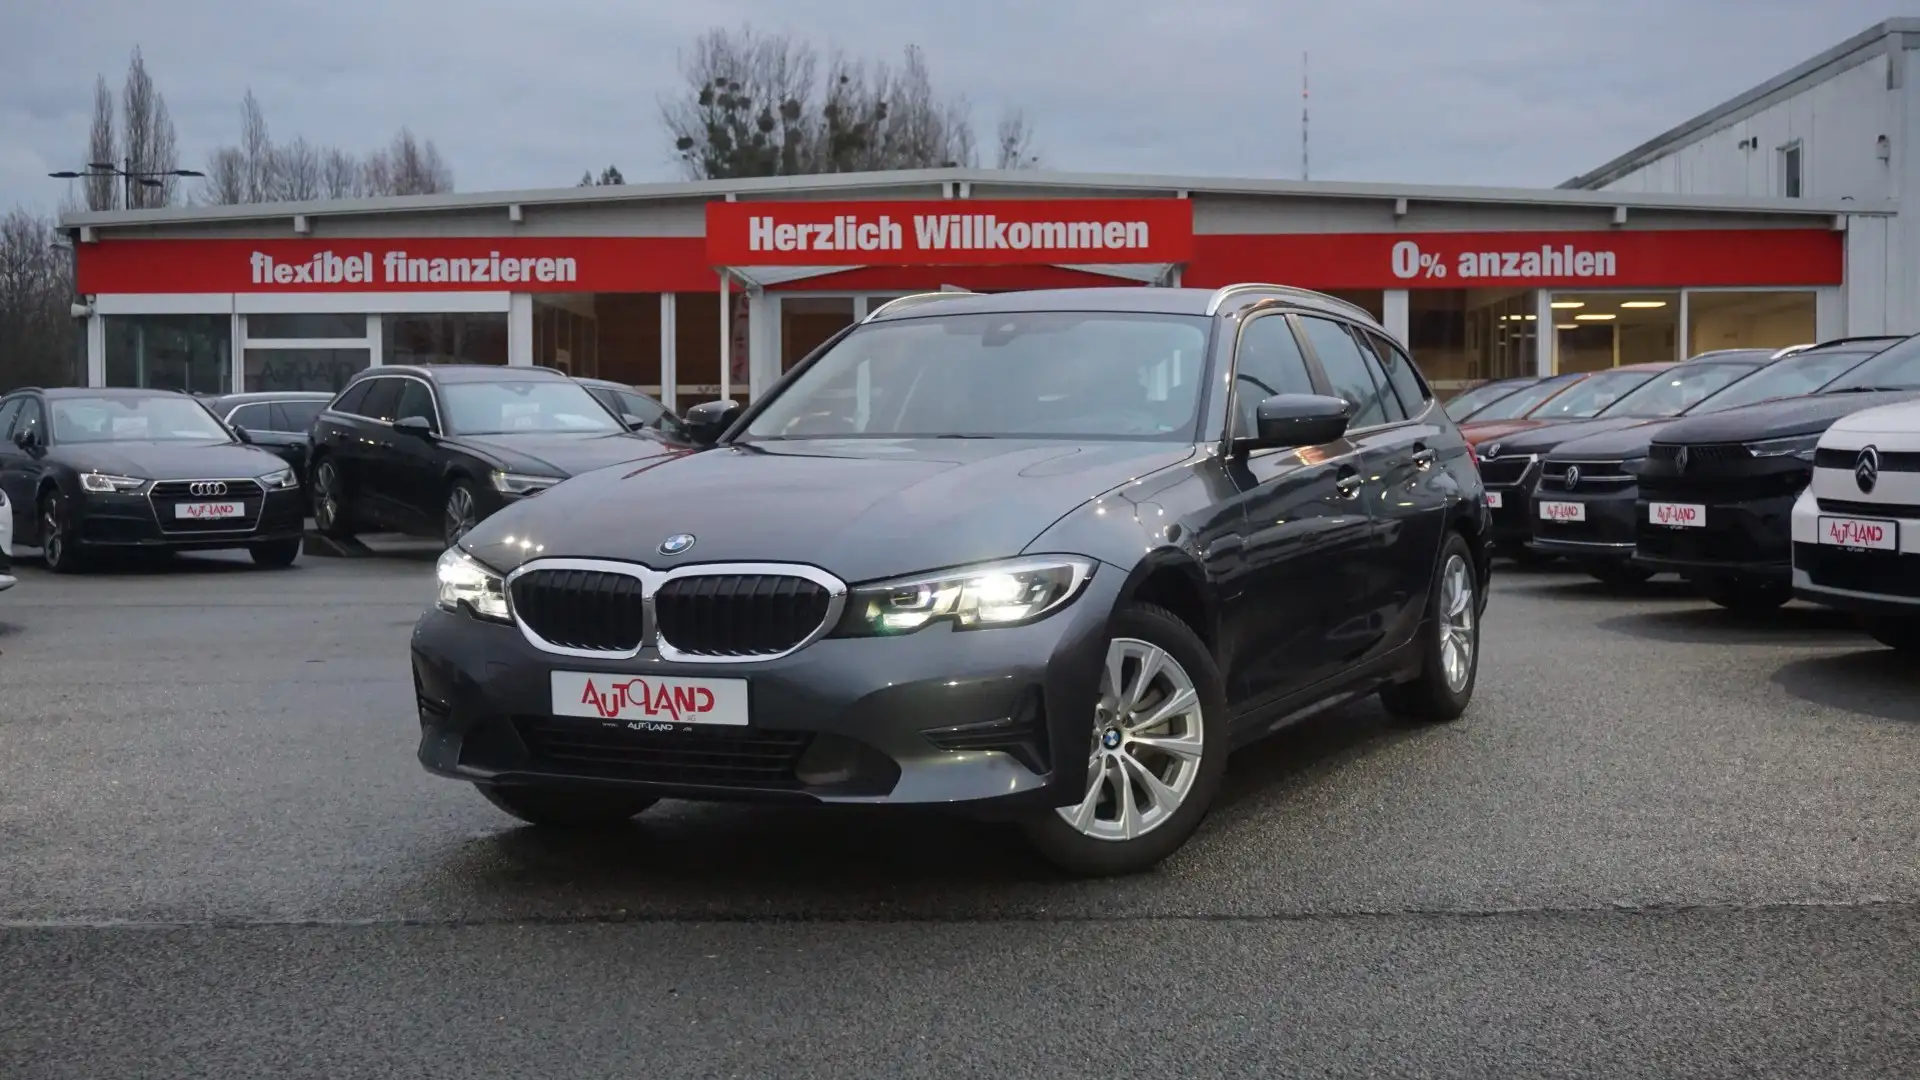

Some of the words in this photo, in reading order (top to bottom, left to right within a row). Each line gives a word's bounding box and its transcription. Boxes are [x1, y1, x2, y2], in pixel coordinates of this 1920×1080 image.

[749, 216, 903, 252] Herzlich
[913, 215, 1149, 250] Willkommen
[250, 251, 373, 284] flexibel
[382, 251, 577, 283] finanzieren
[1391, 241, 1447, 279] 0%
[1457, 245, 1616, 278] anzahlen
[1830, 521, 1883, 546] AUTOLAND
[582, 678, 715, 720] AUTOLAND
